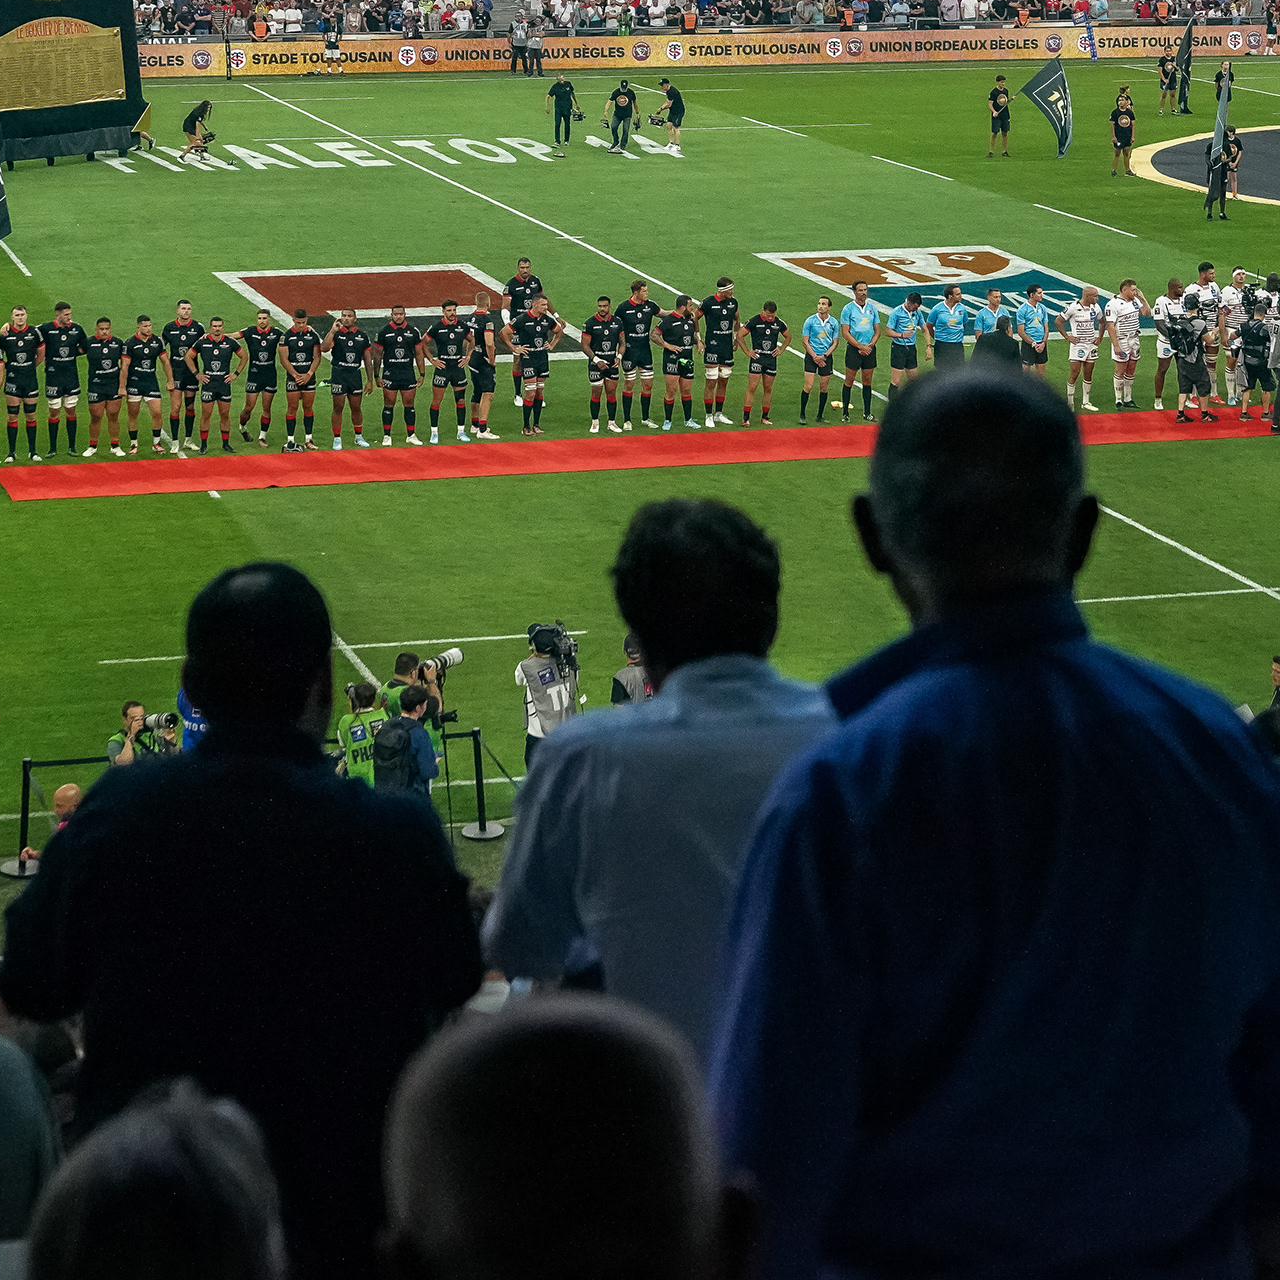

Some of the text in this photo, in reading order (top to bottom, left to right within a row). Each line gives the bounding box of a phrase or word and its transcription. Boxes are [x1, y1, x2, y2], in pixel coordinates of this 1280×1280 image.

[869, 35, 1039, 53] UNION BORDEAUX BÈGLES
[1098, 35, 1222, 48] STADE TOULOSAIN
[252, 50, 393, 65] STADE TOUOUSAIN
[444, 43, 625, 61] UNION BOAUX BÈGLES
[688, 43, 821, 57] STADE TOULOUSAIN
[139, 52, 185, 67] ÈGLES
[392, 136, 555, 165] TOP
